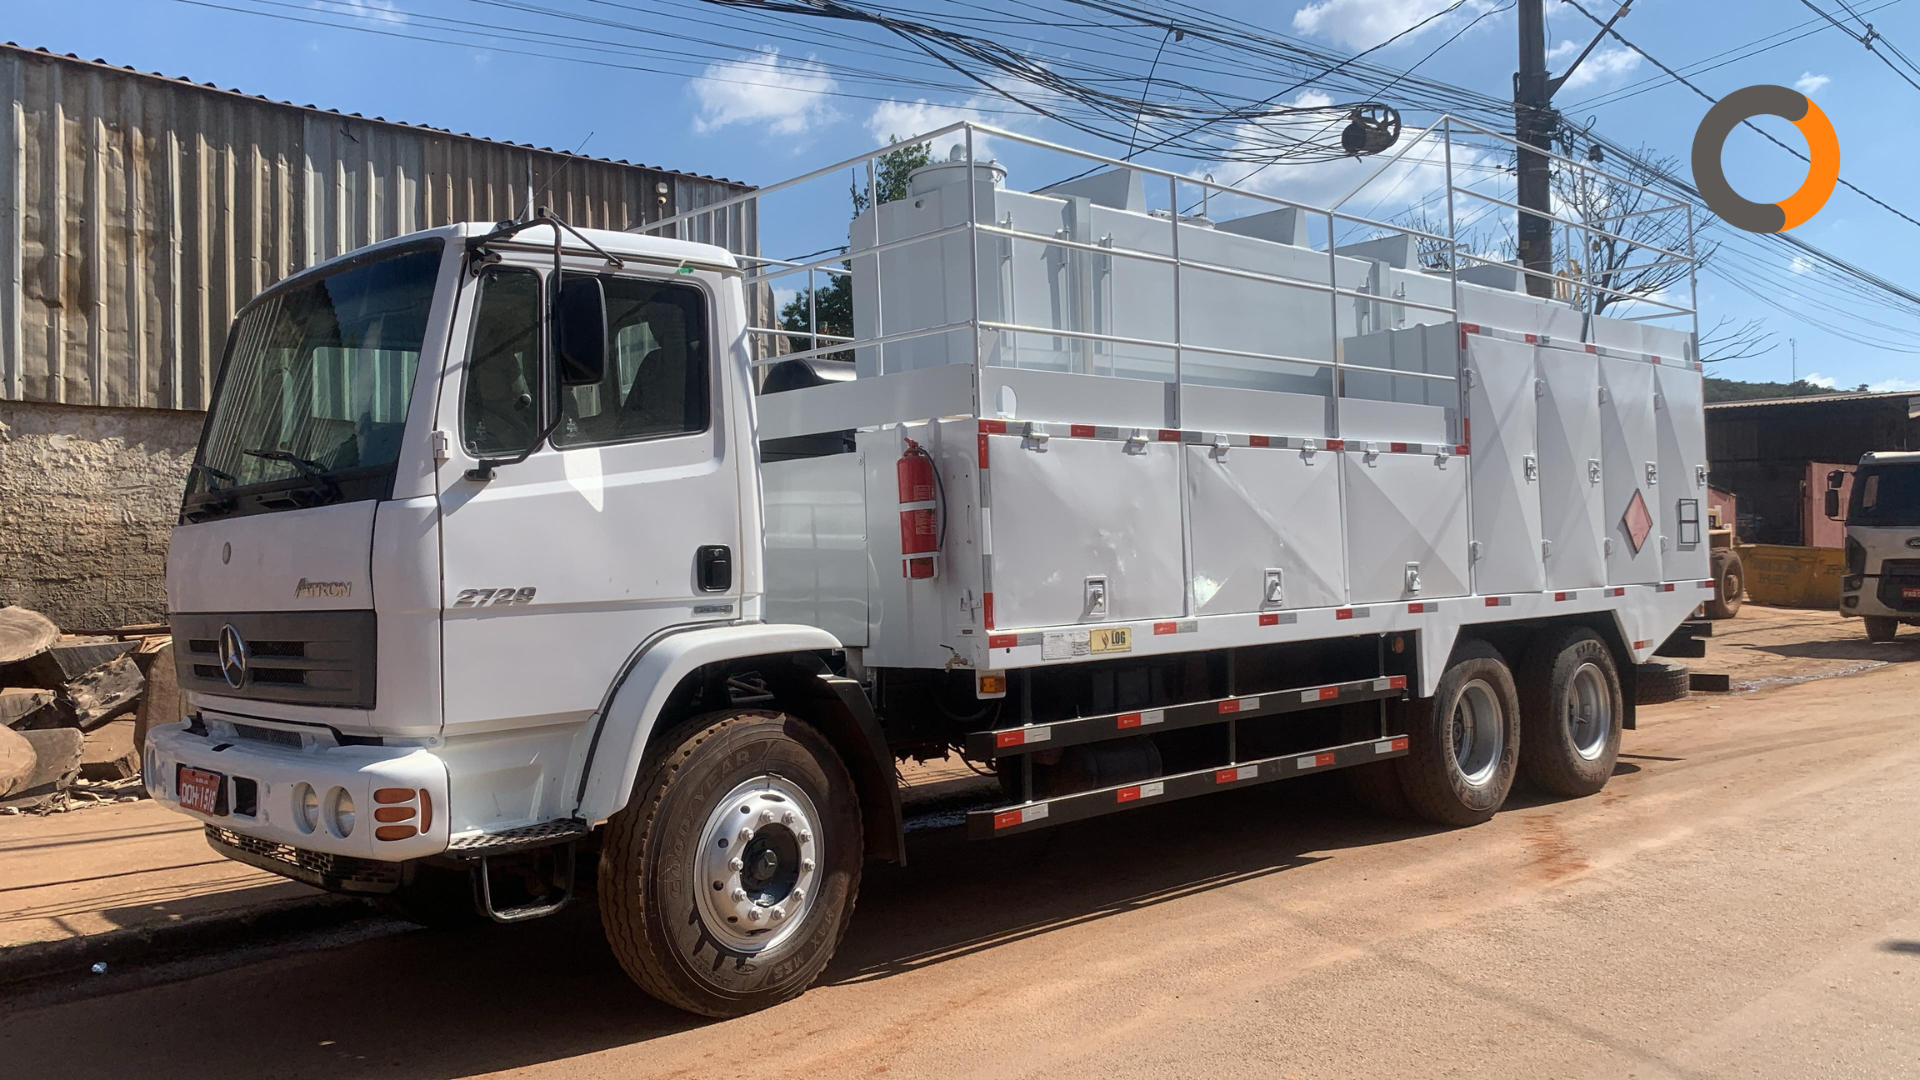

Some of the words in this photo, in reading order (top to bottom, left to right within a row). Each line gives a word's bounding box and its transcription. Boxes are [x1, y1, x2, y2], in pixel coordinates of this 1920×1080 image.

[294, 578, 352, 598] ATRON
[453, 587, 536, 608] 2729
[1111, 631, 1126, 645] LOG
